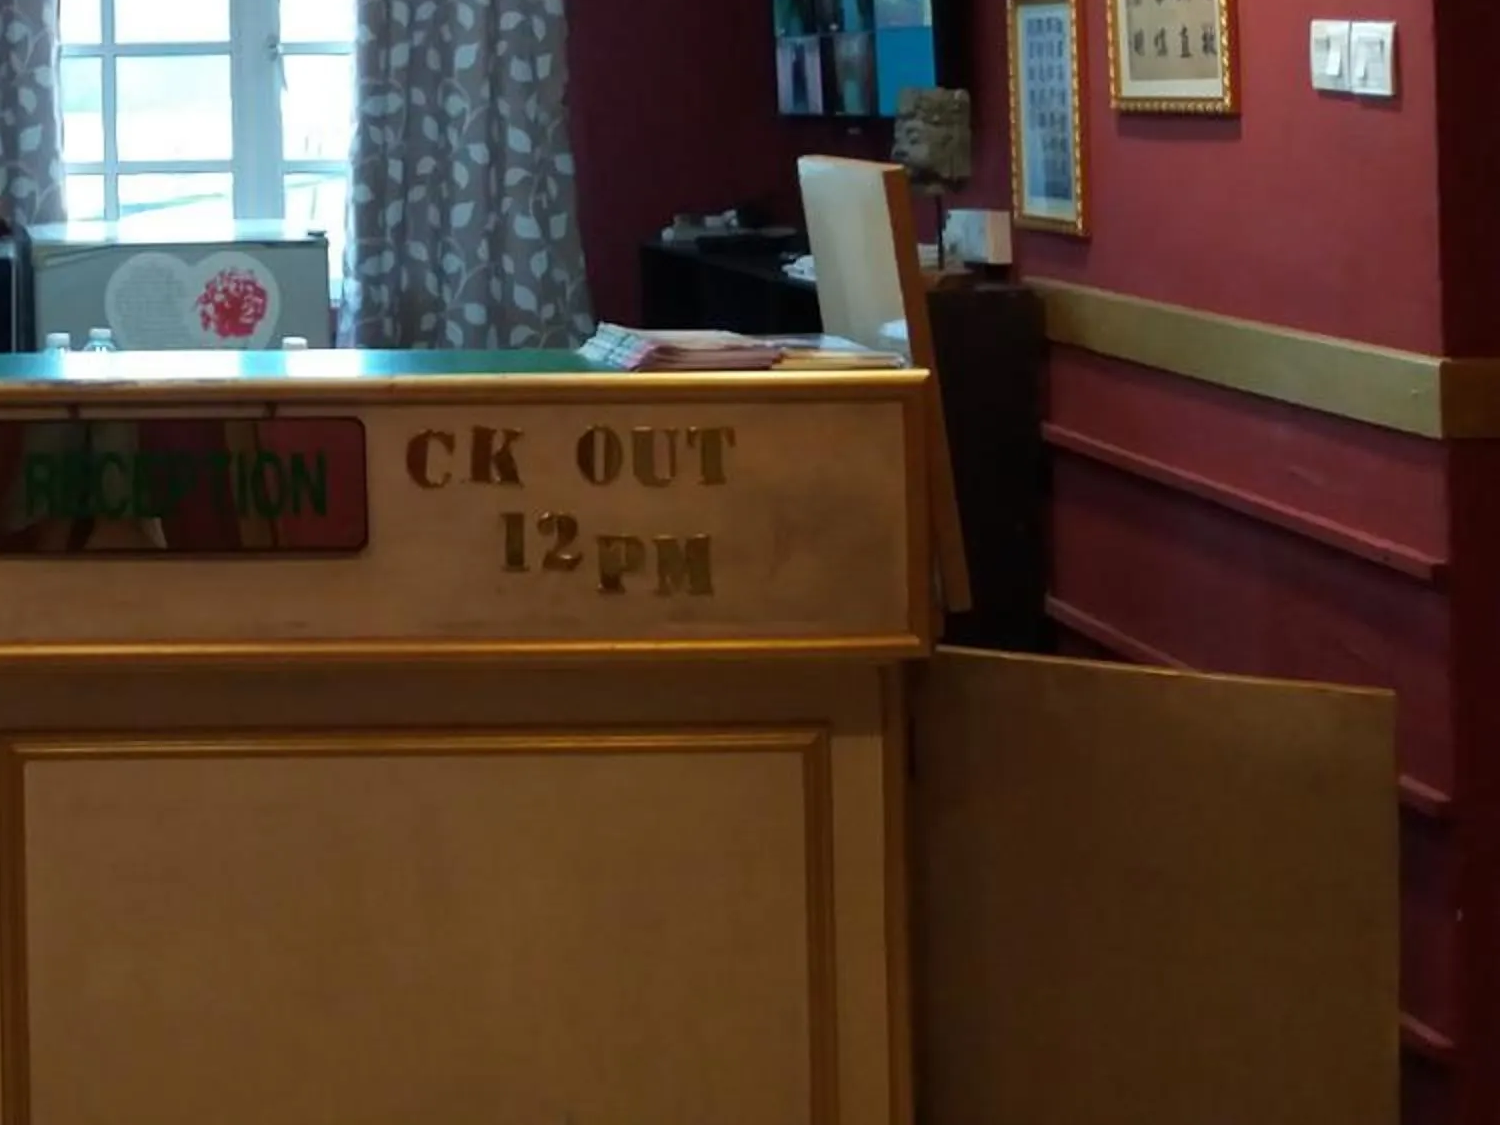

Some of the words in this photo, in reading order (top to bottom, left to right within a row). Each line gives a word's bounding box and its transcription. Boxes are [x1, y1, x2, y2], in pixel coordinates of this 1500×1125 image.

[23, 450, 328, 520] RECEPTION
[405, 425, 525, 490] CK
[576, 424, 737, 488] OUT
